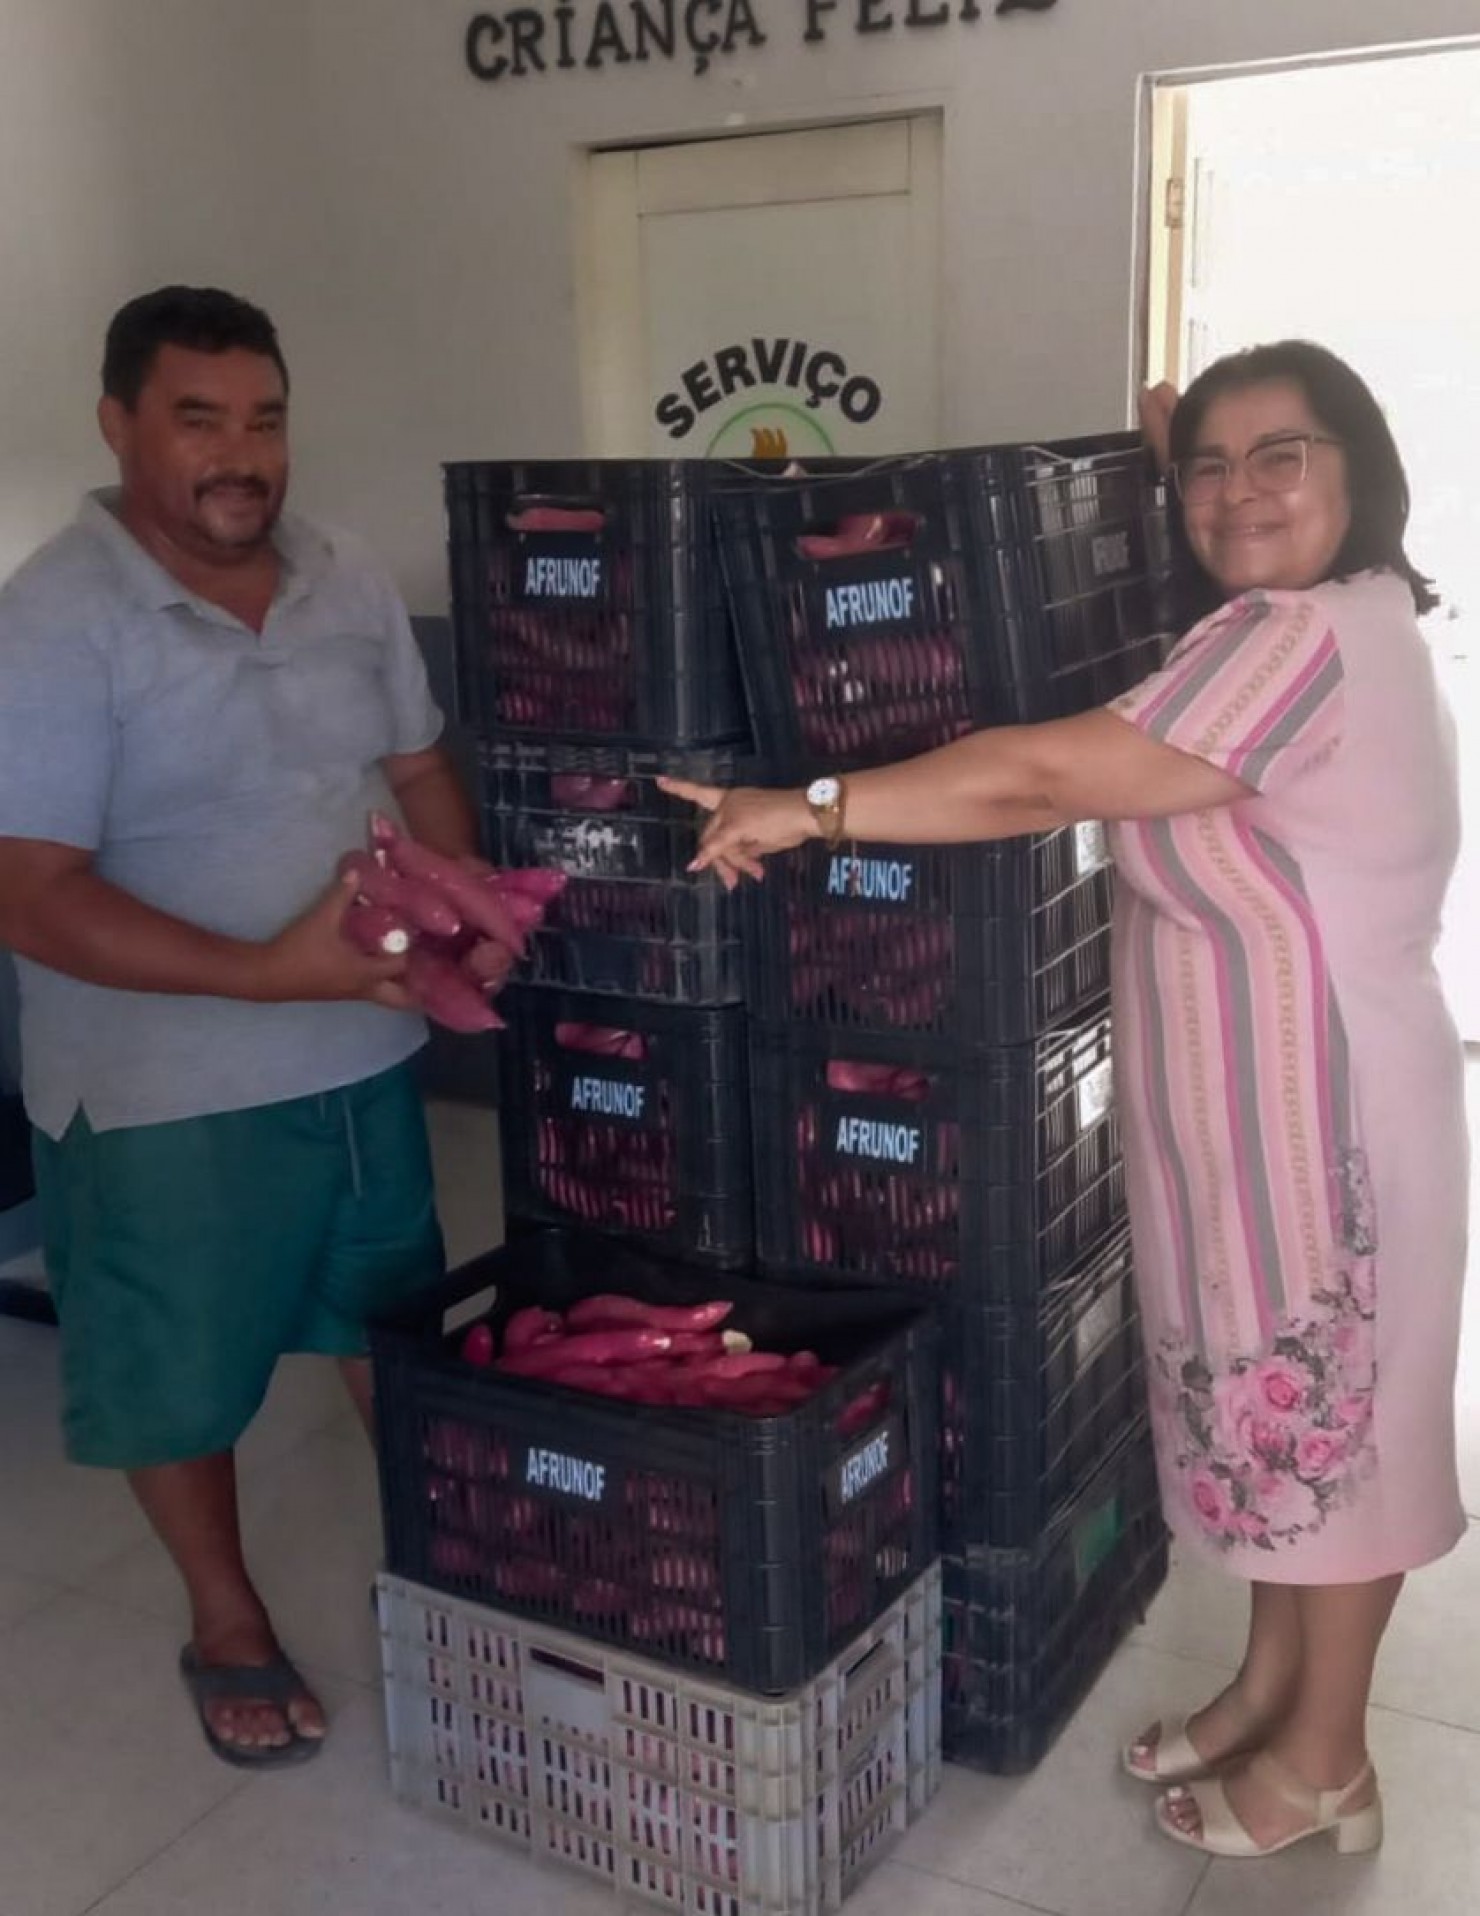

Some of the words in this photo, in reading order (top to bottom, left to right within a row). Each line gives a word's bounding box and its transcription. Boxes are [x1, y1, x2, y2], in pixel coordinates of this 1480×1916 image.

[465, 0, 766, 80] CRIANÇA
[803, 0, 1056, 42] FEL
[655, 338, 881, 438] SERVIÇO
[525, 558, 600, 597] AFRUNOF
[826, 578, 913, 629] AFRUNOF
[827, 857, 912, 900] AFRUNOF
[572, 1077, 645, 1118] AFRUNOF
[837, 1117, 919, 1164] AFRUNOF
[527, 1448, 605, 1500] AFRUNOF
[841, 1431, 888, 1504] AFRUNOF
